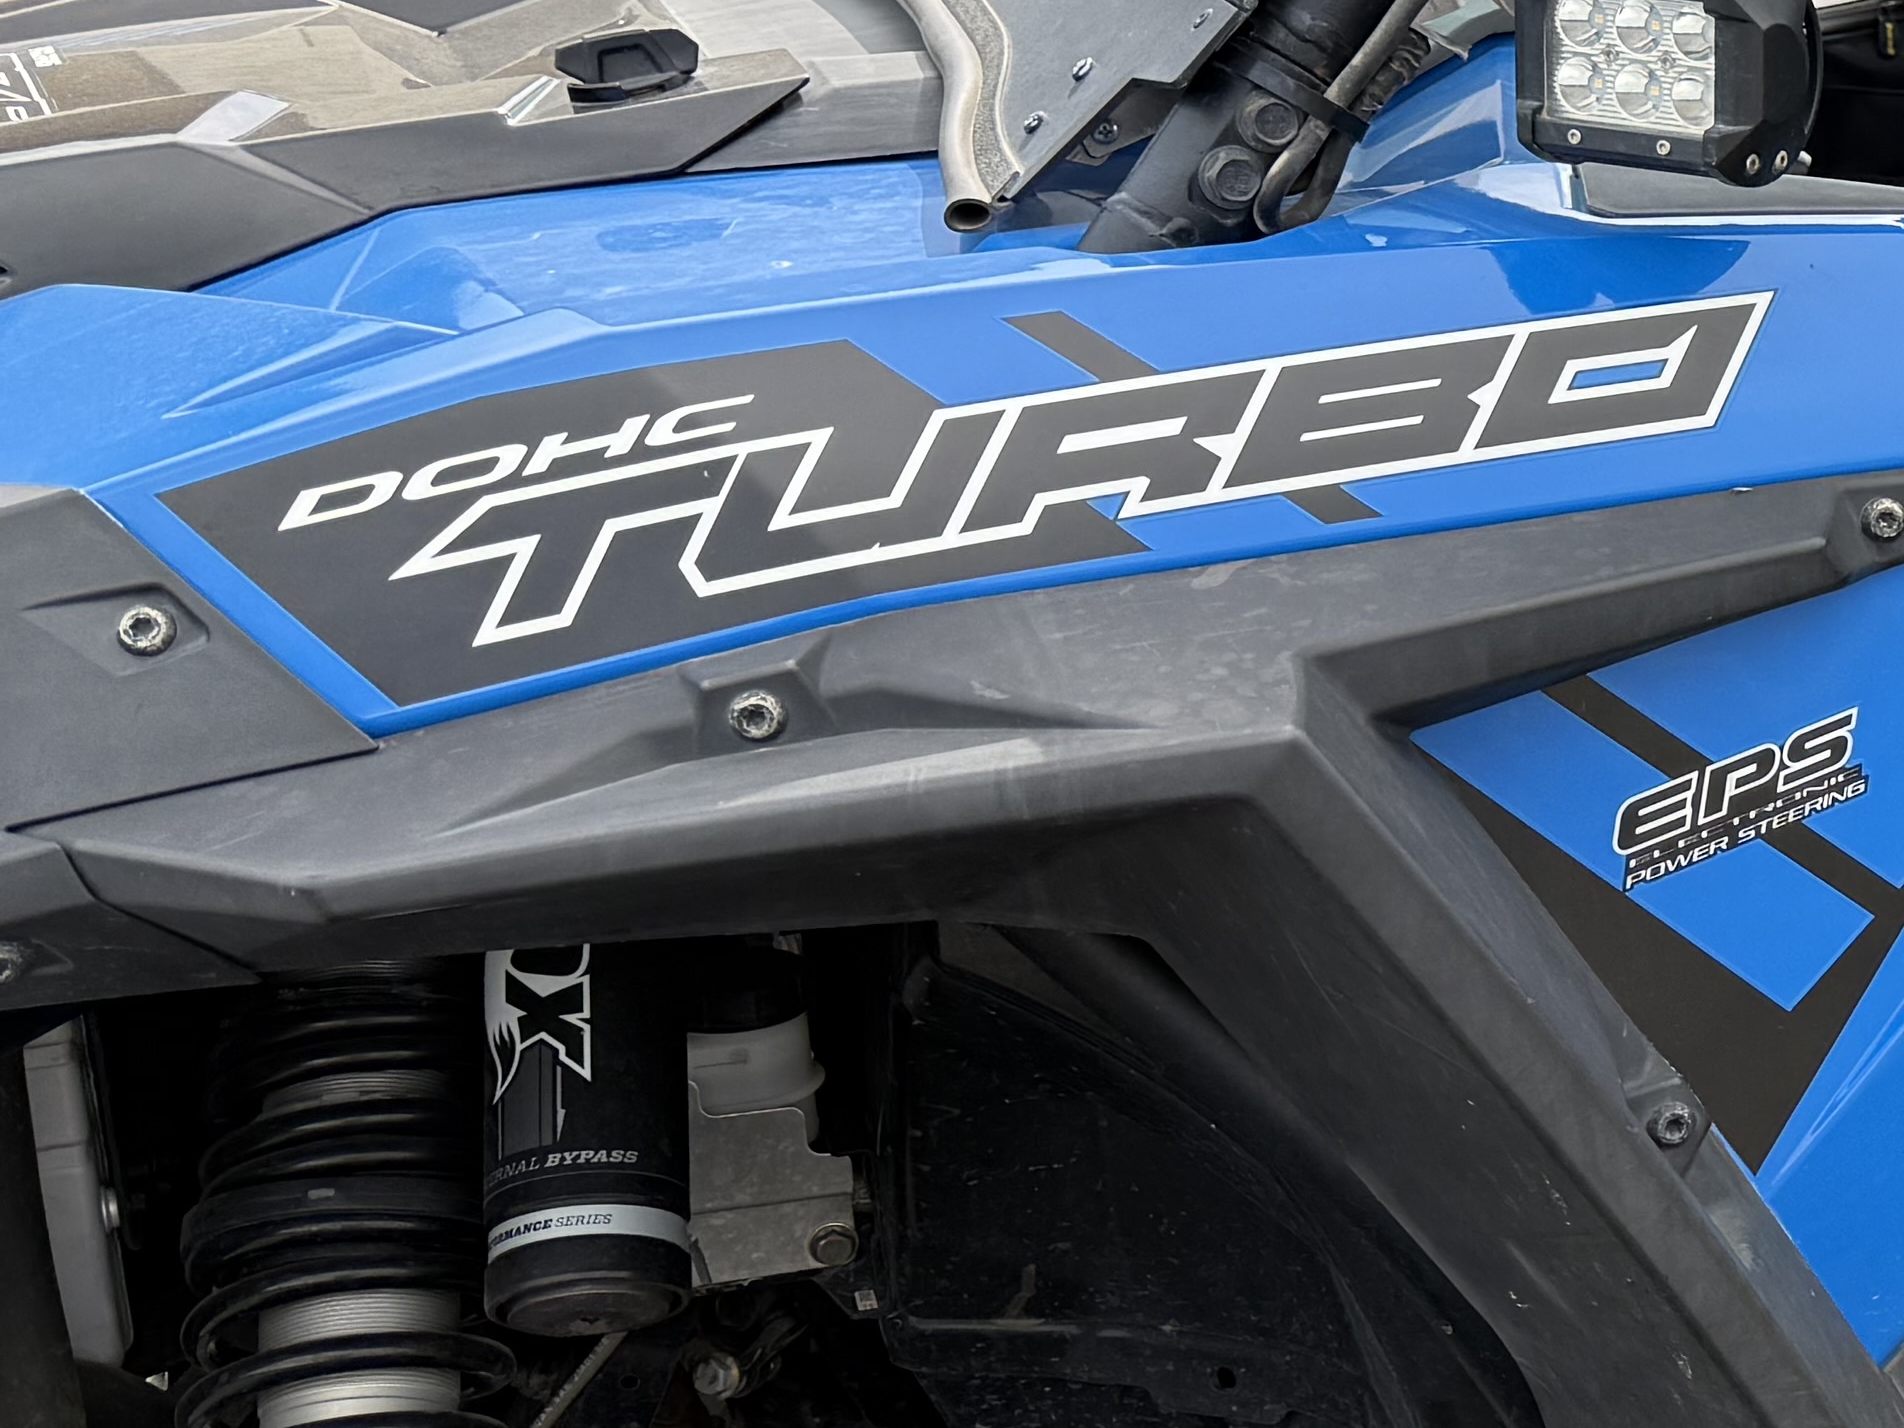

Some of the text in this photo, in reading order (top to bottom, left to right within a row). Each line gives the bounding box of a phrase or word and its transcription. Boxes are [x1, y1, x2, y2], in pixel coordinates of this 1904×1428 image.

[277, 394, 755, 531] DOHC
[389, 290, 1778, 648] TURBO
[1612, 706, 1859, 856] EPS
[1625, 781, 1866, 890] POWER STEERING
[543, 1150, 639, 1168] BYPASS
[554, 1213, 613, 1228] SERIES
